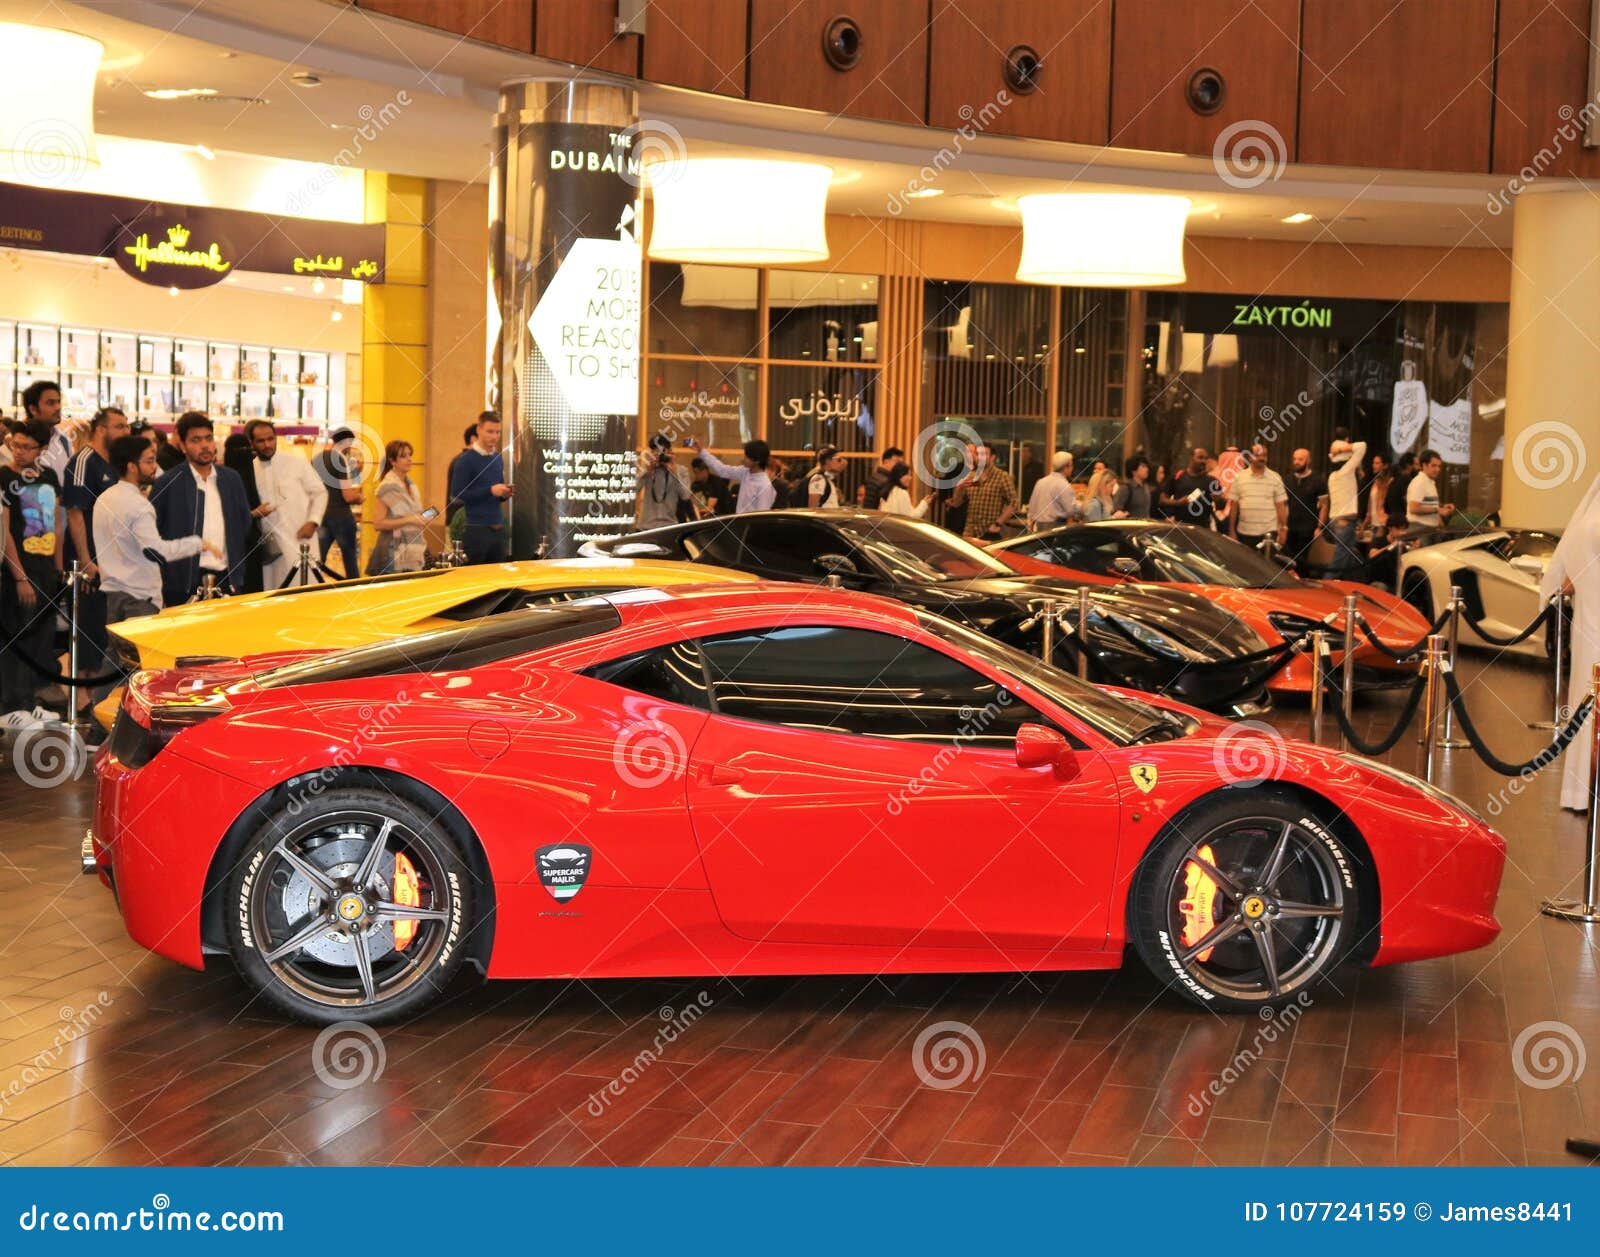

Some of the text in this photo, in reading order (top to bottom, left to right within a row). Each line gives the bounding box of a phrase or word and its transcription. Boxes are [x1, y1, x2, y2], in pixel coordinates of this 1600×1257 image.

[609, 133, 632, 148] THE
[550, 150, 623, 174] DUBAI
[0, 226, 43, 241] EETINGS
[124, 233, 230, 272] Hallmark
[561, 325, 639, 351] REASO
[565, 354, 600, 377] TO
[542, 449, 573, 460] We're
[574, 450, 602, 464] giving
[603, 453, 623, 463] away
[543, 462, 573, 474] Cards
[575, 463, 589, 475] for
[590, 464, 609, 475] AED
[555, 477, 565, 487] to
[567, 475, 608, 488] celebrate
[555, 488, 566, 500] of
[567, 489, 597, 501] Dubai
[1298, 816, 1354, 889] MICHELIN
[543, 868, 584, 877] SUPERCARS
[551, 876, 577, 884] MAJLIS
[239, 850, 264, 948] MICHELIN
[440, 871, 463, 967] MICHELIN
[1158, 930, 1215, 1001] MICHELIN
